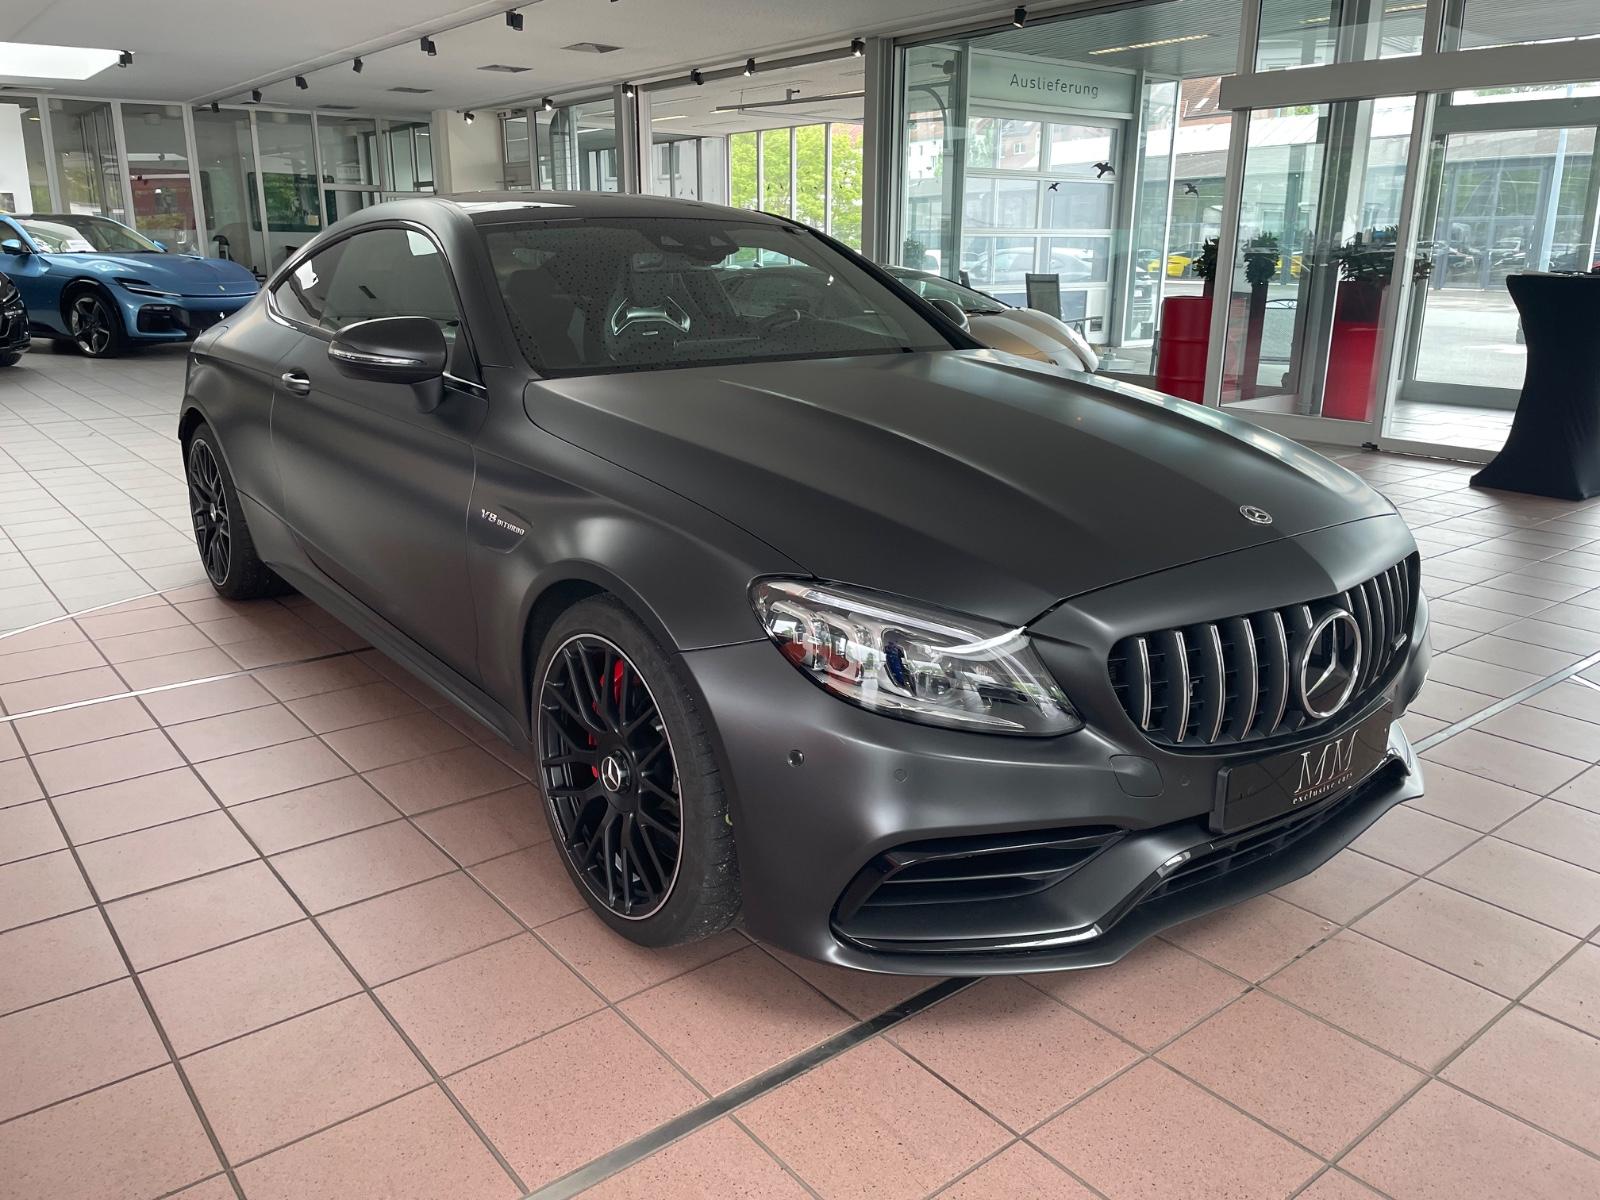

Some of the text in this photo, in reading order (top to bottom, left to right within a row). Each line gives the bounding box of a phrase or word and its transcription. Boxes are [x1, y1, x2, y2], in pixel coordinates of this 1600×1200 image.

[1010, 73, 1099, 99] Auslieferung
[481, 508, 525, 536] V8 BITURBO
[1293, 729, 1360, 794] MM
[1292, 782, 1335, 805] exclusive
